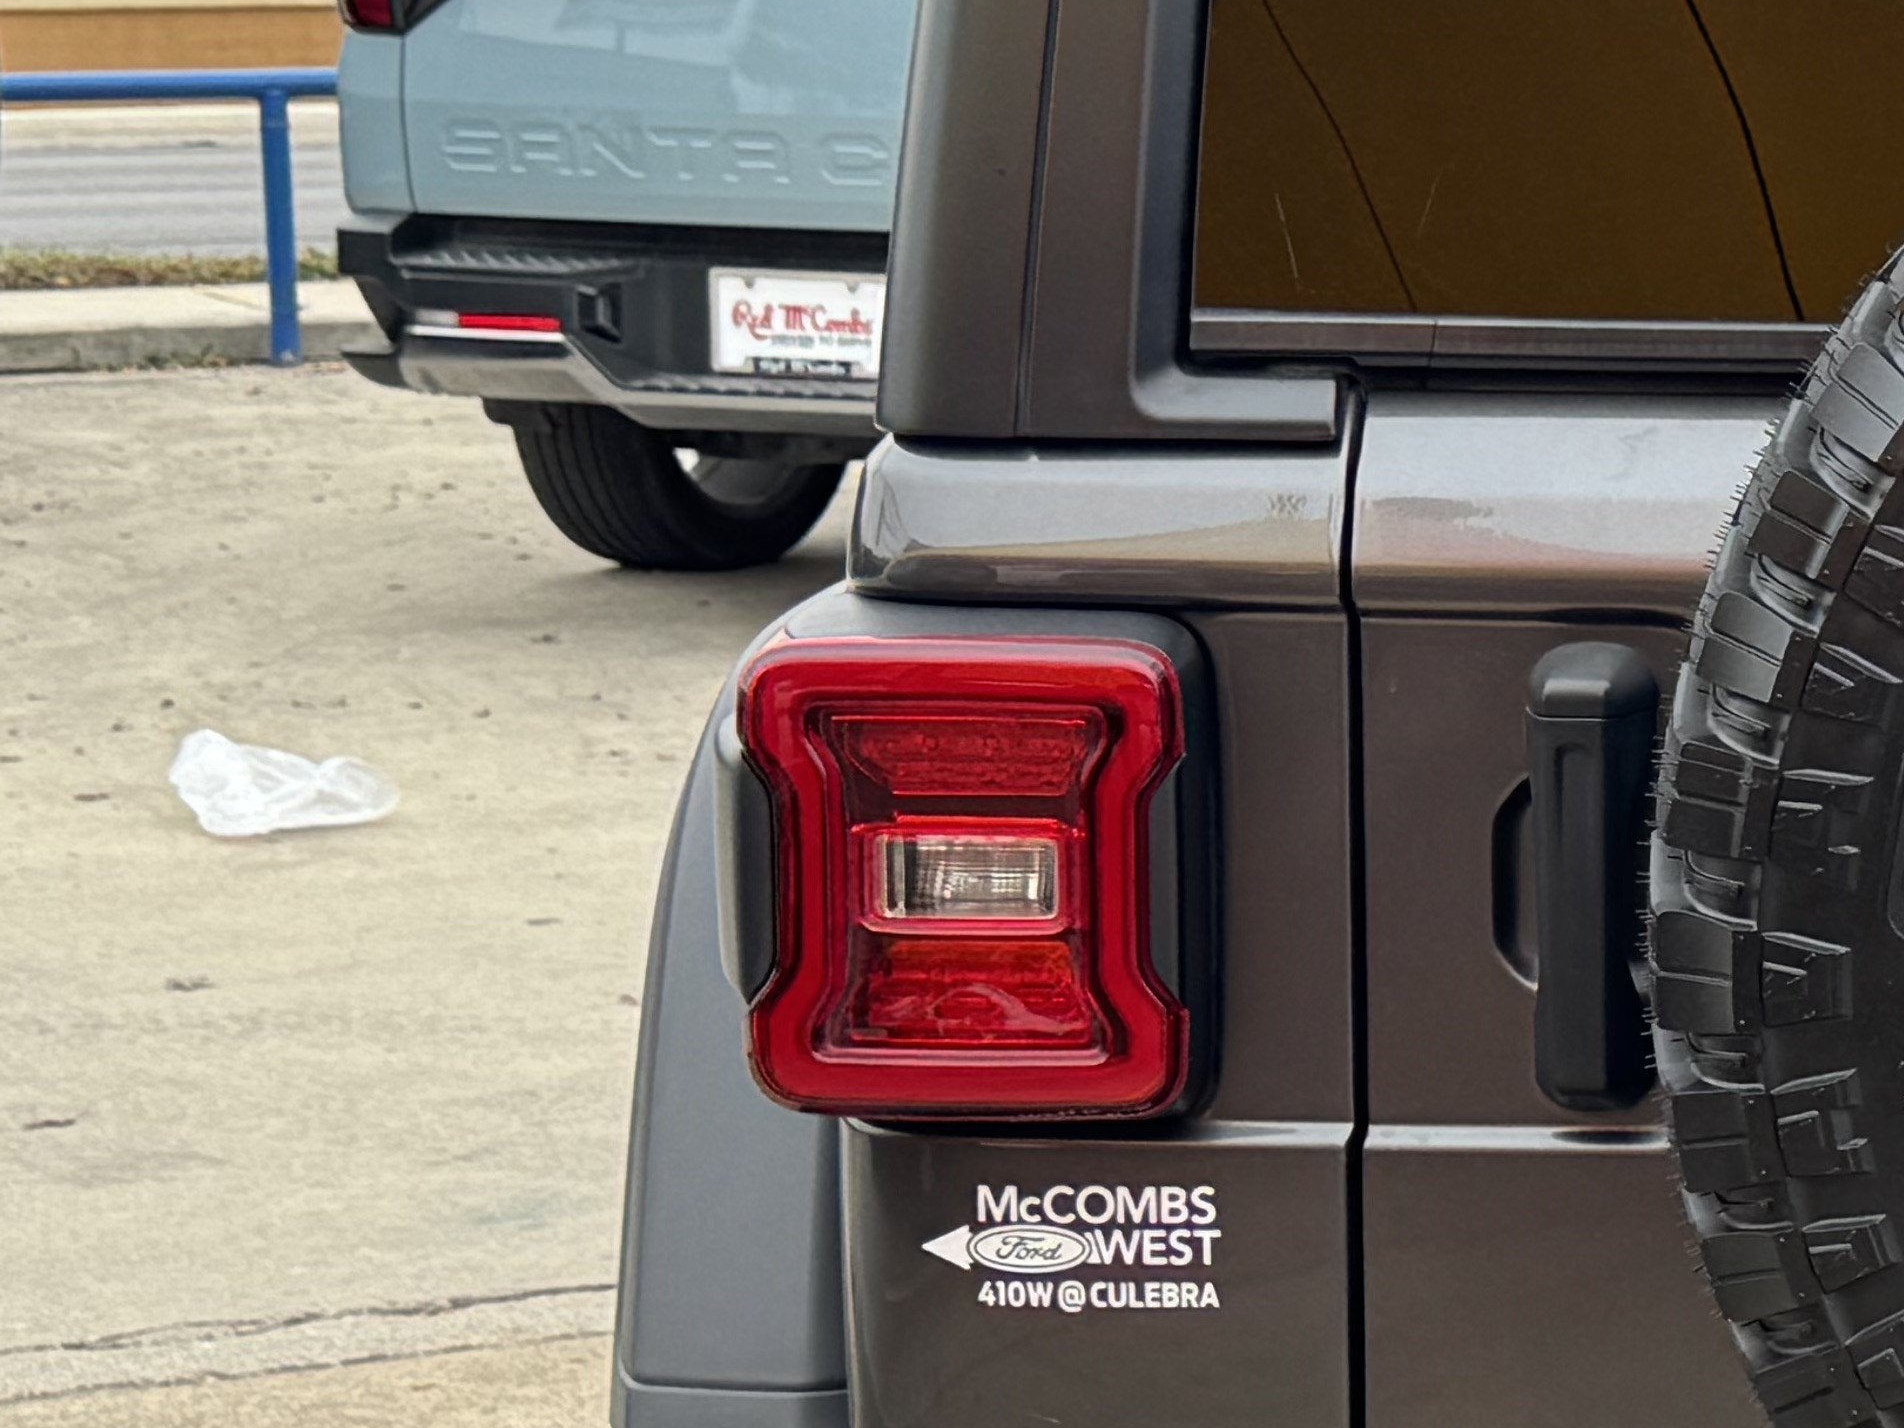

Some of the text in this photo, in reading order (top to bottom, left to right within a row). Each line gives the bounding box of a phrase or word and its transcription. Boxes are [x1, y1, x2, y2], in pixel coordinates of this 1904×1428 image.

[440, 120, 792, 186] SANTA
[976, 1184, 1217, 1224] McCOMBS
[996, 1229, 1221, 1265] Ford WEST
[1091, 1281, 1220, 1308] CULEBRA
